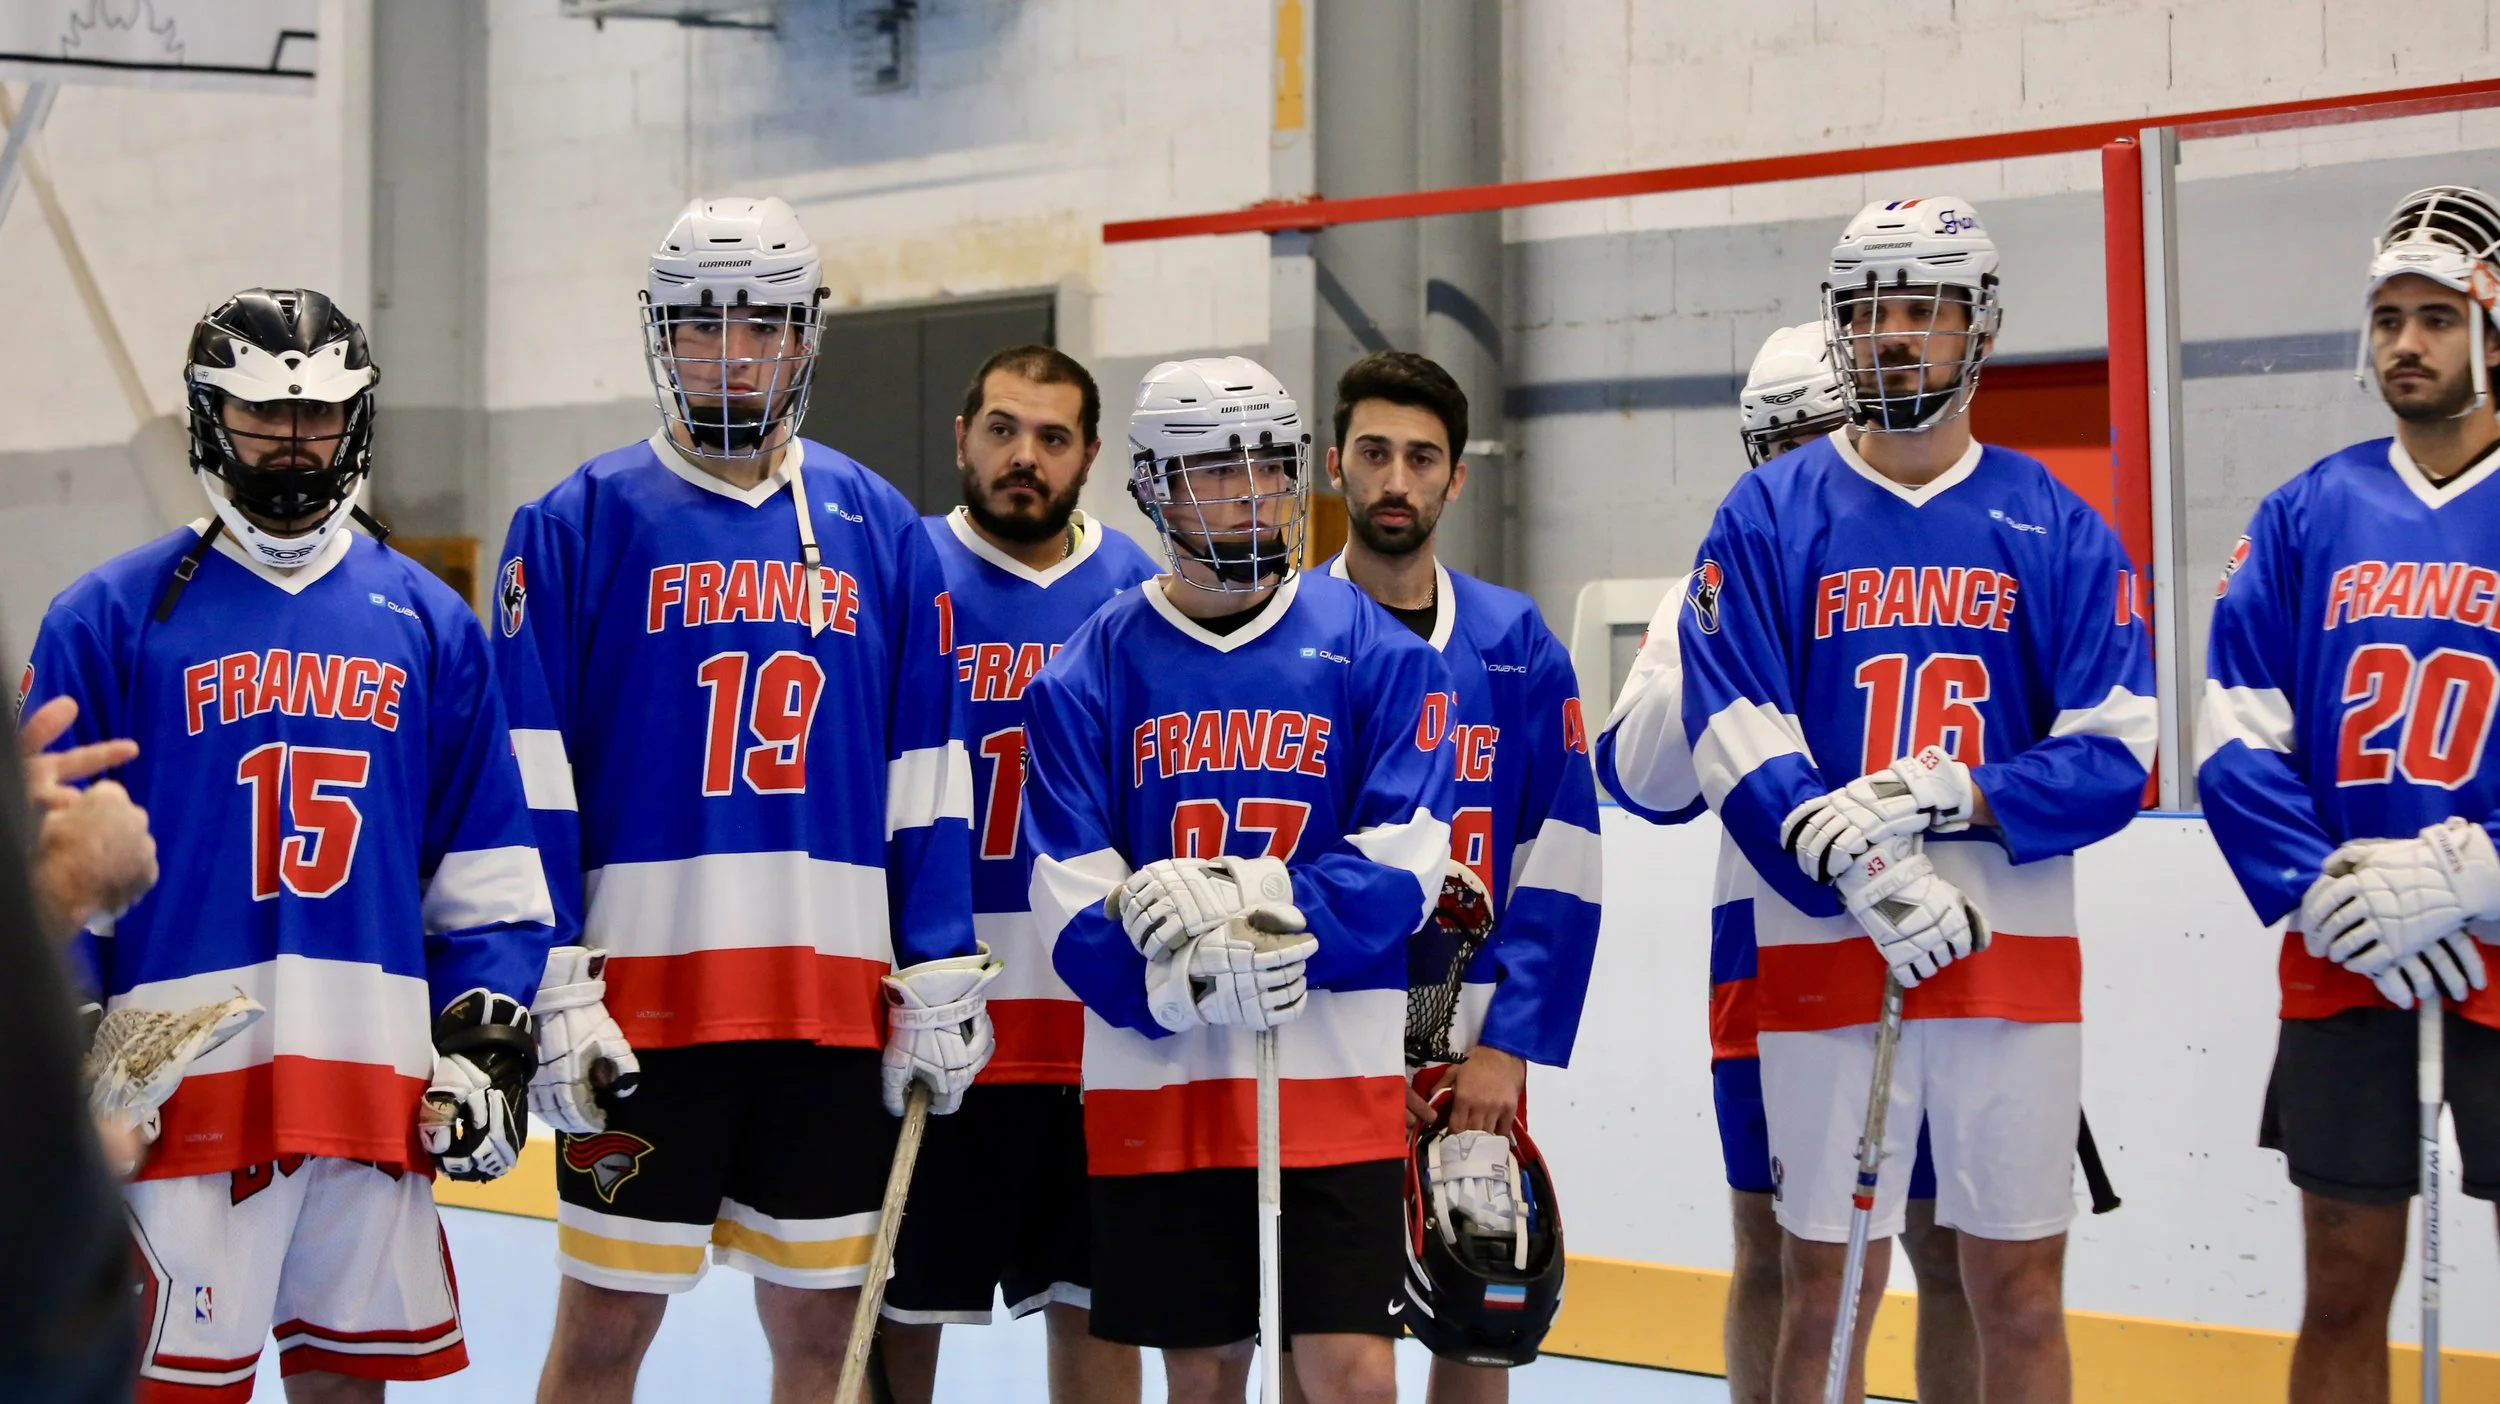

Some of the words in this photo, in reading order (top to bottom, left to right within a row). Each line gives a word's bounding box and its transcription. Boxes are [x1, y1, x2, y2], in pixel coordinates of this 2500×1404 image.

[698, 259, 752, 268] WARRIOR
[1863, 241, 1912, 251] WARRIOR
[1221, 402, 1270, 413] WARRIOR
[647, 560, 858, 635] FRANCE
[1815, 566, 2018, 639] FRANCE
[185, 648, 407, 735] FRANCE
[697, 651, 825, 797] 19
[1855, 653, 1990, 775] 16
[2335, 643, 2500, 791] 20
[1134, 709, 1331, 788] FRANCE
[1921, 750, 1939, 771] 33
[237, 742, 369, 902] 15
[1171, 797, 1312, 865] 07
[1866, 856, 1886, 877] 33
